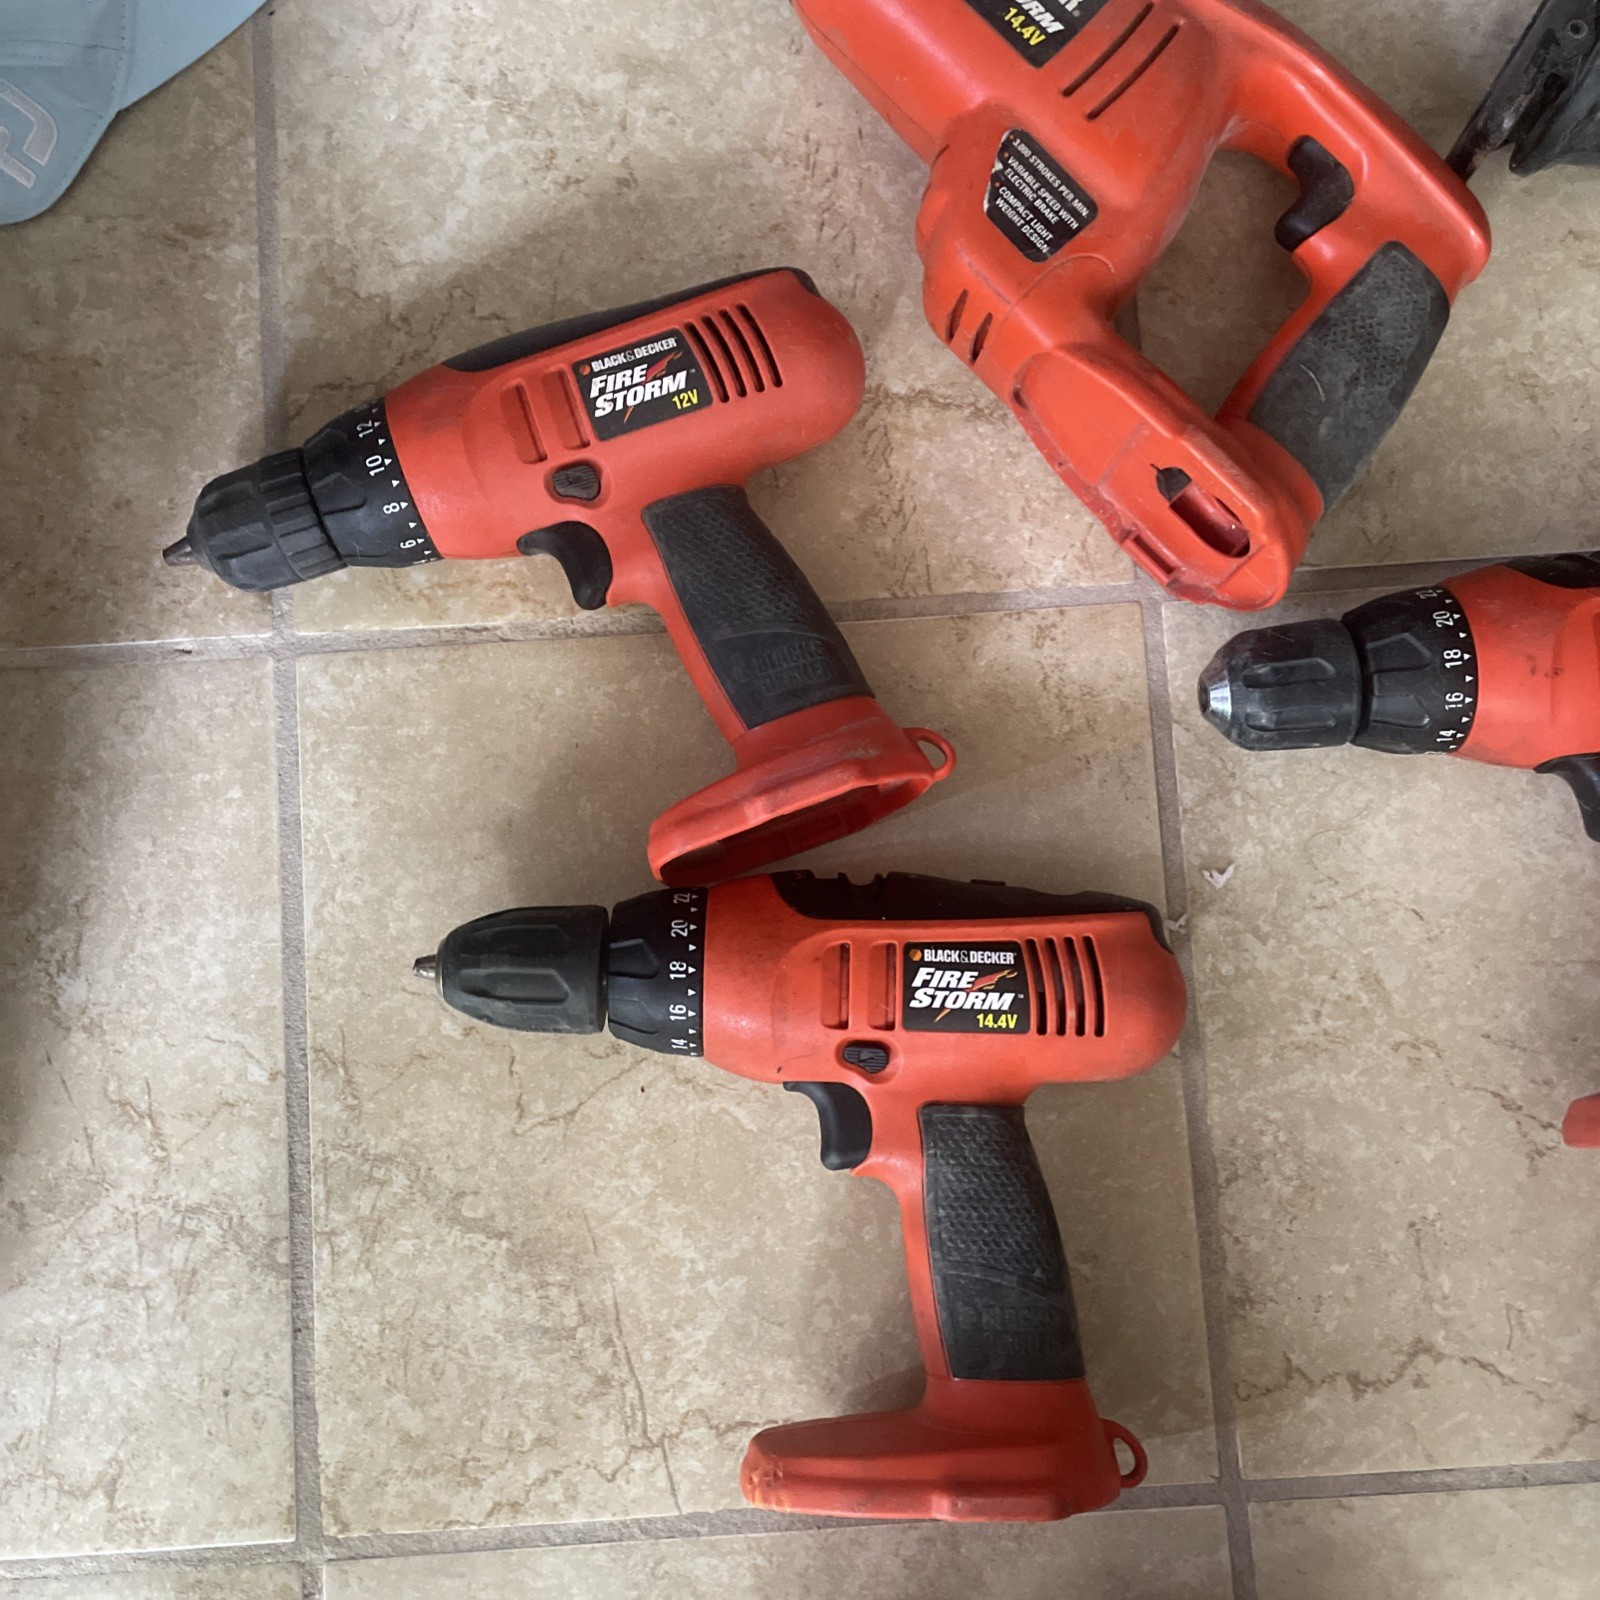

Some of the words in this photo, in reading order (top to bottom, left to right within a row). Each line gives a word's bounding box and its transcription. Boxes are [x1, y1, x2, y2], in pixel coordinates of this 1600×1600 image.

[1004, 7, 1046, 46] 14.4V
[1029, 155, 1061, 188] STROKES
[1058, 185, 1076, 204] PER
[1004, 168, 1035, 202] ELECTRIC
[1034, 198, 1059, 225] BRAKE
[1007, 156, 1039, 190] VARIABLE
[1037, 187, 1061, 211] SPEED
[1058, 206, 1079, 230] WITH
[999, 186, 1032, 221] COMPACT
[1030, 218, 1053, 241] LIGHT
[995, 197, 1023, 228] WEIGHT
[1021, 225, 1050, 254] DESIGN
[590, 364, 648, 399] FIRE
[594, 370, 687, 417] STORM
[672, 389, 698, 410] 12V
[356, 419, 374, 439] 12
[365, 454, 385, 477] 10
[383, 502, 400, 515] 8
[1433, 610, 1454, 628] 20
[1443, 649, 1463, 669] 18
[1445, 692, 1464, 710] 16
[1436, 729, 1457, 742] 14
[671, 919, 688, 938] 20
[669, 961, 687, 980] 18
[911, 967, 979, 989] FIRE
[909, 987, 1015, 1011] STORM
[669, 1004, 687, 1021] 16
[976, 1013, 1018, 1029] 14.4V
[671, 1038, 688, 1050] 14
